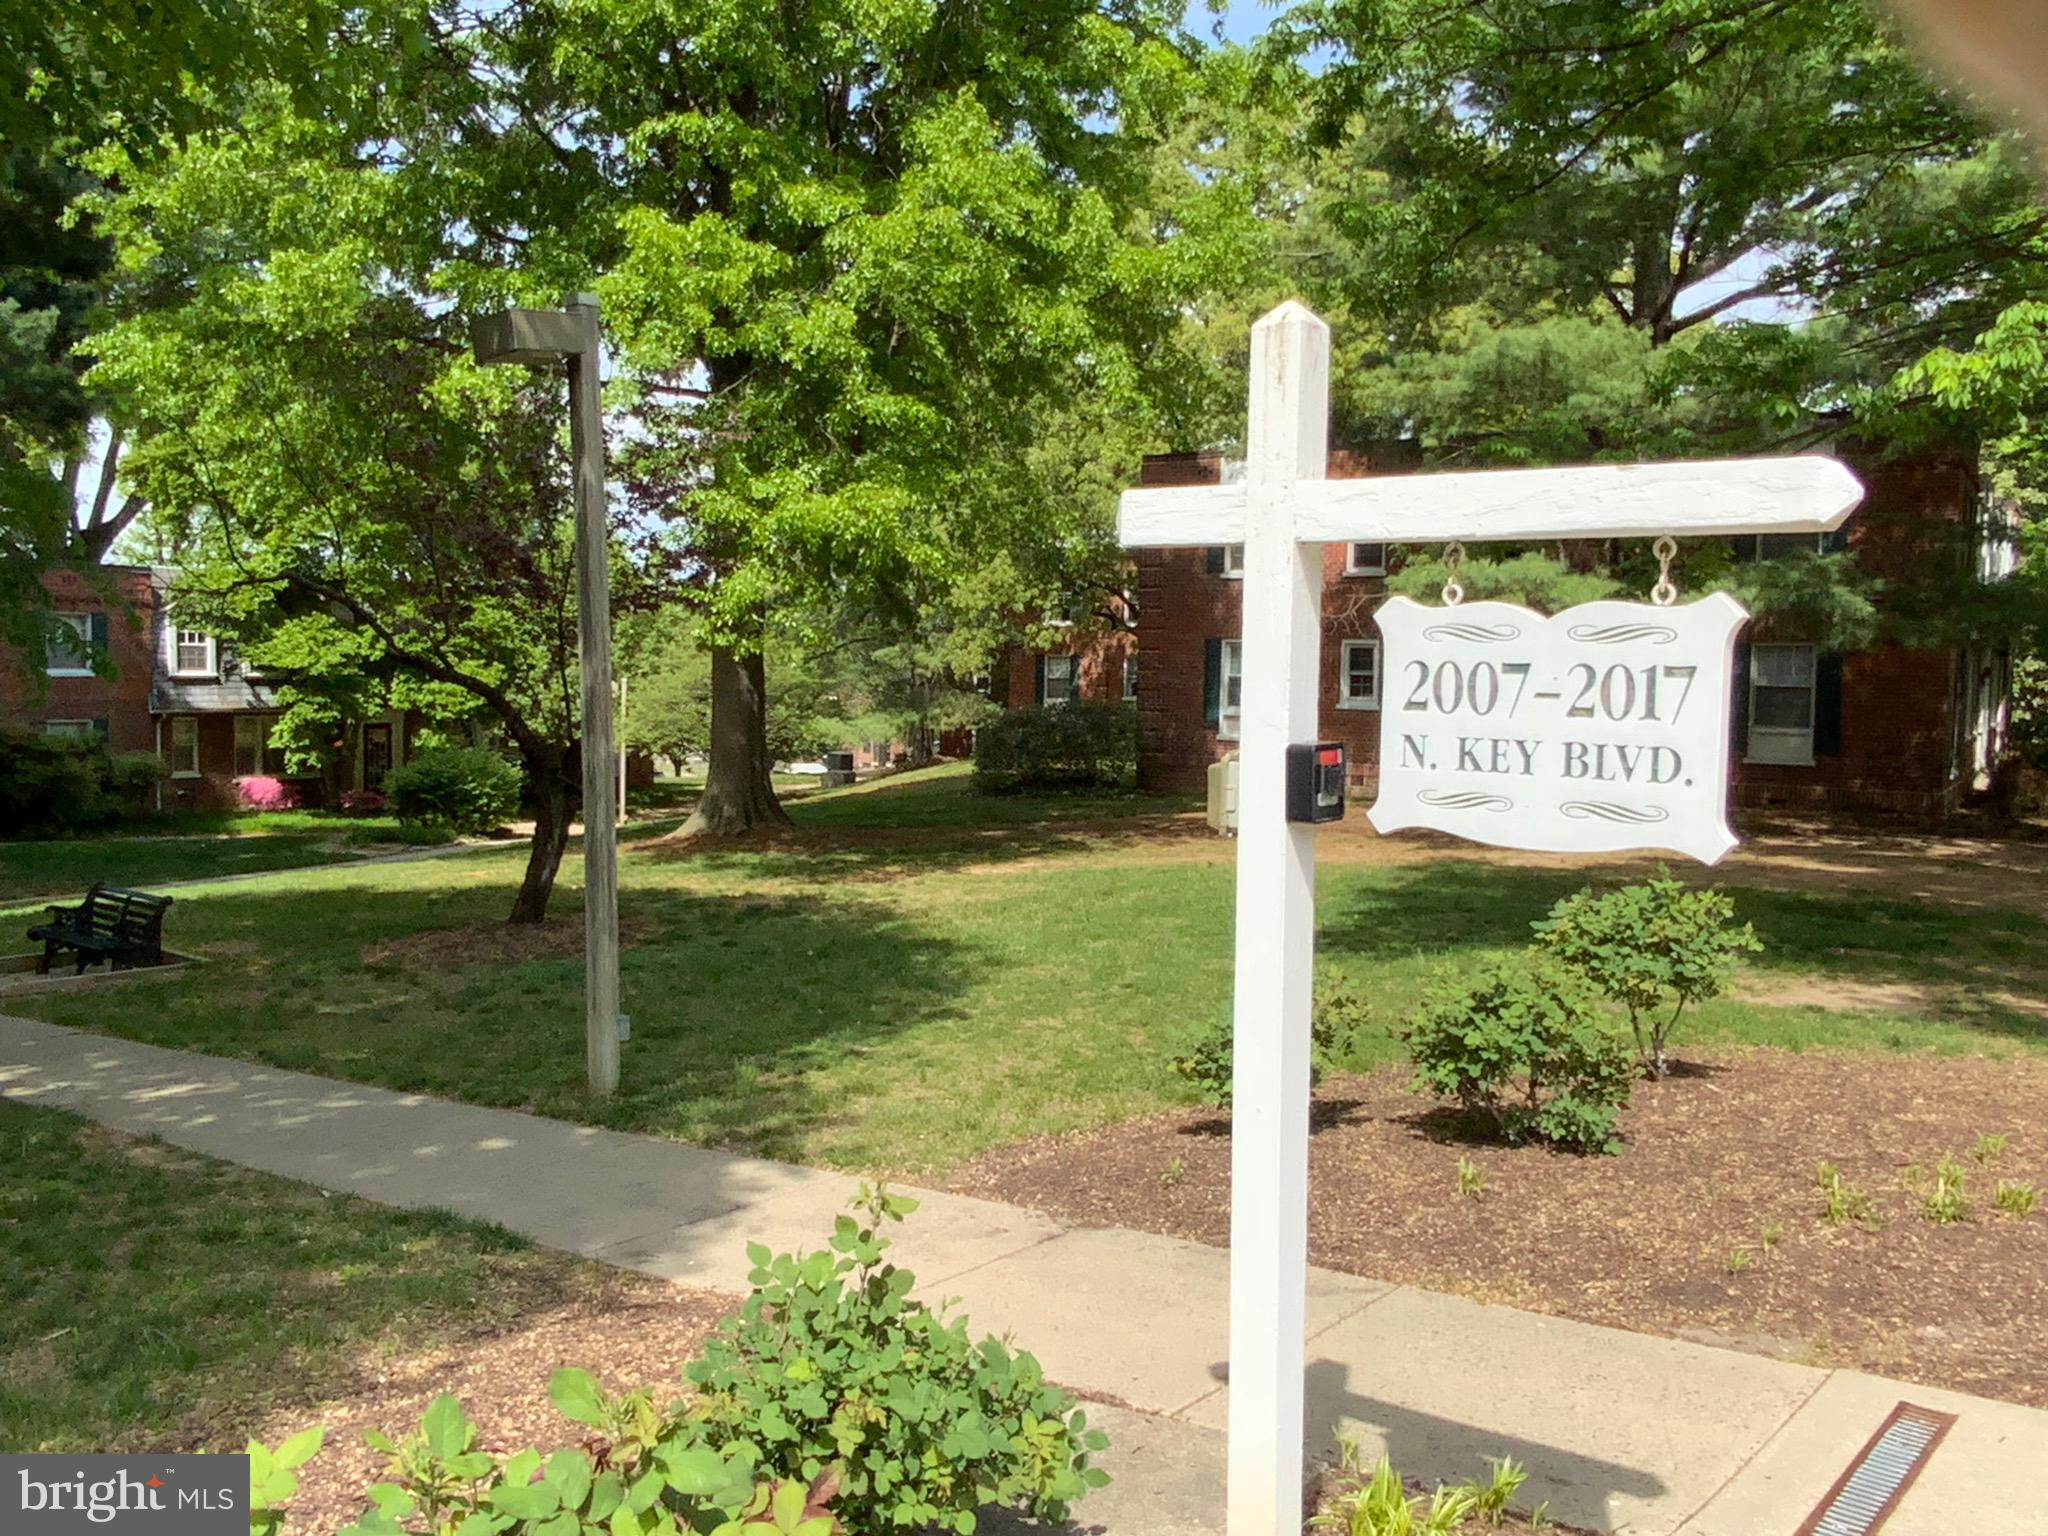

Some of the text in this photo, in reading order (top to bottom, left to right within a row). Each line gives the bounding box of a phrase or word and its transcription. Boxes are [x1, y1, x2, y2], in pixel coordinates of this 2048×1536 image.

[1402, 659, 1698, 726] 2007-2017
[1400, 733, 1694, 788] N. KEY BLVD.
